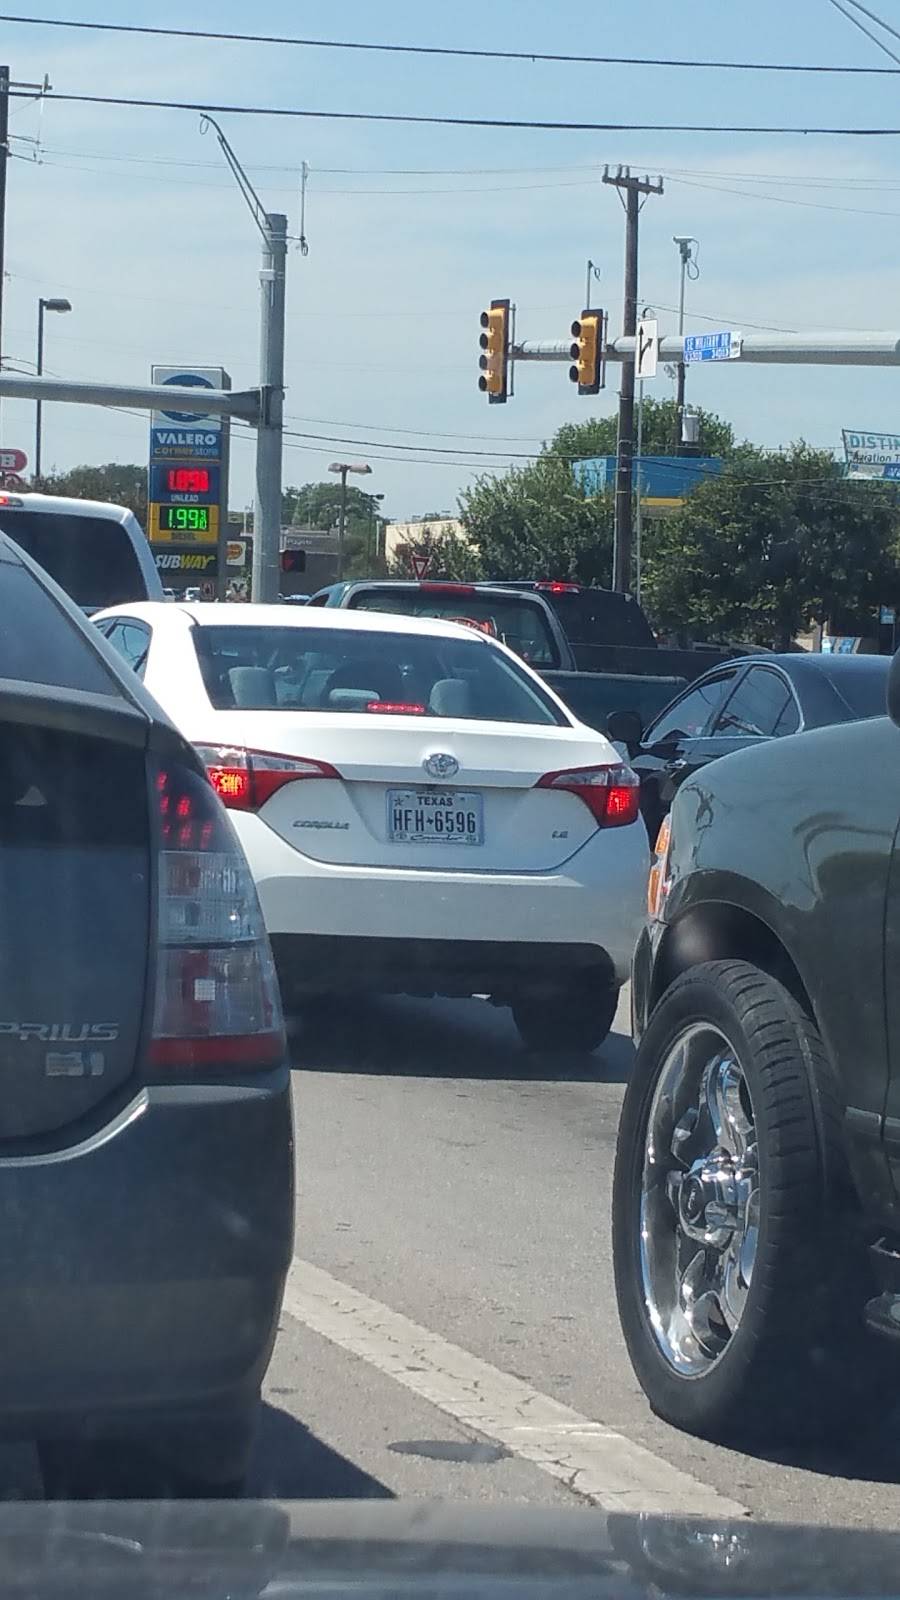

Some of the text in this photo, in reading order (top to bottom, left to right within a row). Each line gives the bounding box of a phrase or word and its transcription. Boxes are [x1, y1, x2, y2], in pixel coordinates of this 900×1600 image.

[156, 432, 217, 446] VALERO
[155, 553, 216, 569] SUBWAY
[416, 796, 454, 807] TEXAS
[0, 1022, 119, 1041] PRIUS
